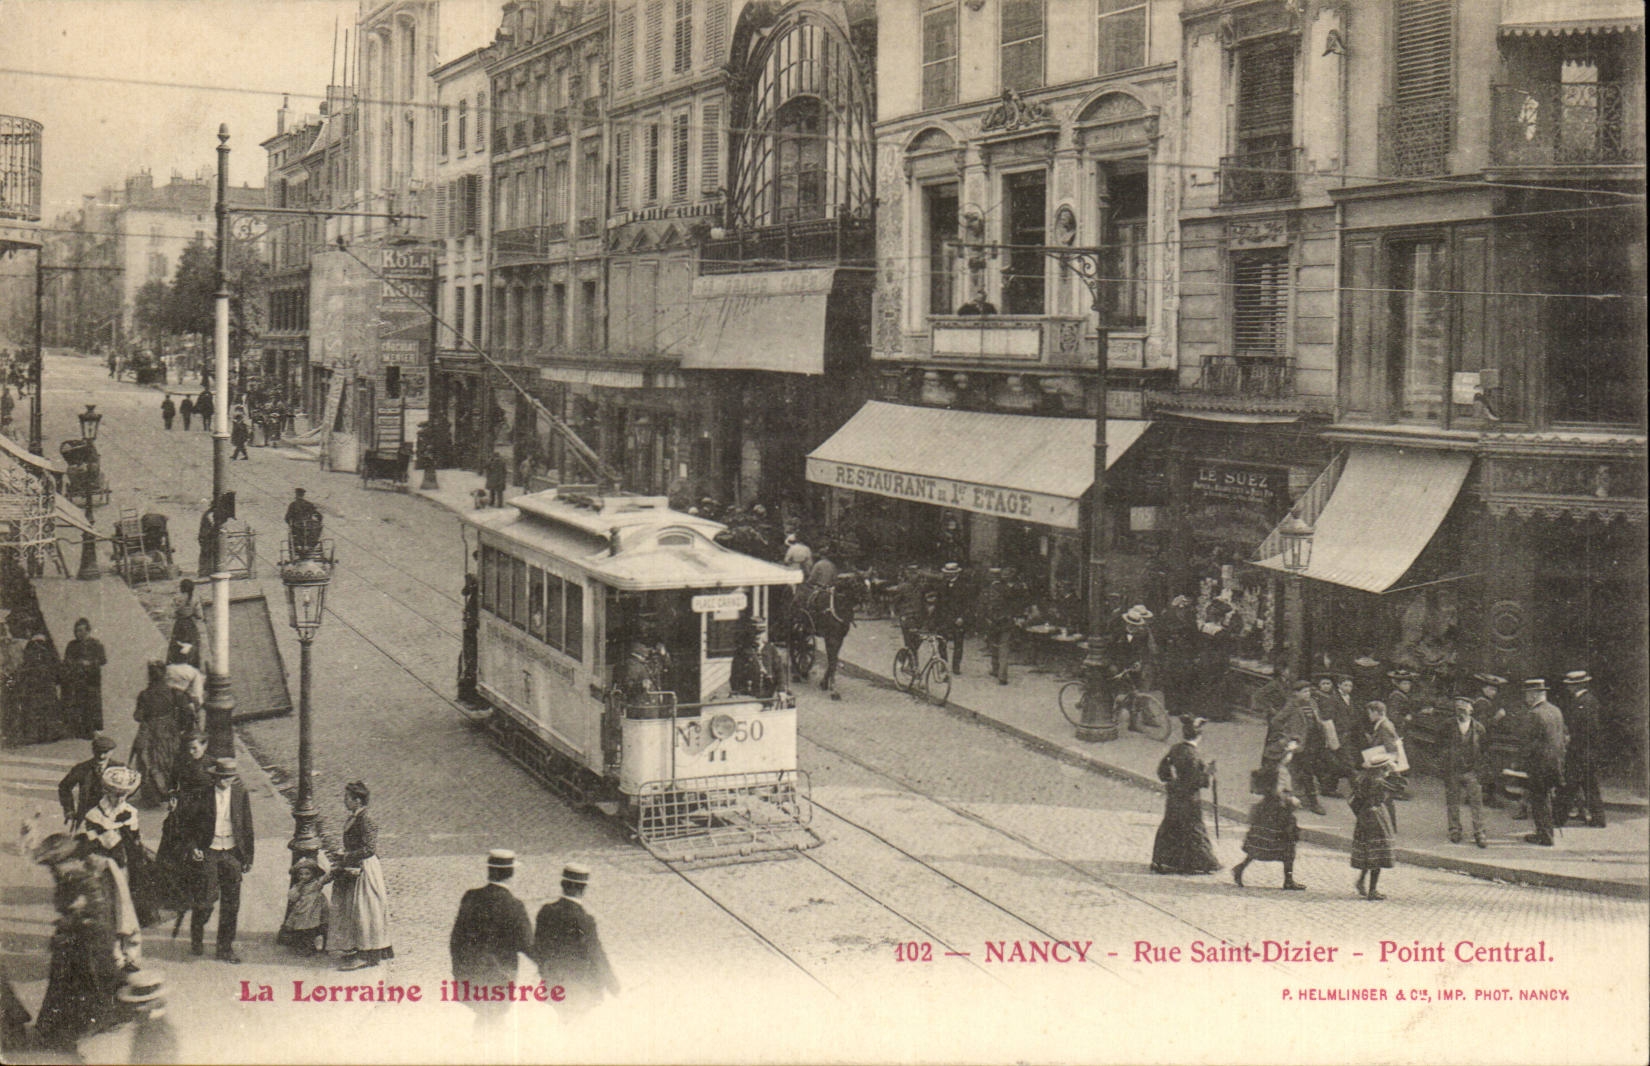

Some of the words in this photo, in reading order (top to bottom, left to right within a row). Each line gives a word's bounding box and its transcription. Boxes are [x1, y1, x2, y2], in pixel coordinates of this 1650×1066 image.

[382, 249, 430, 269] KOLA
[1224, 471, 1269, 488] SUEZ
[835, 466, 936, 500] RESTAURANT
[973, 486, 1032, 517] ETAGE
[735, 719, 764, 742] 50
